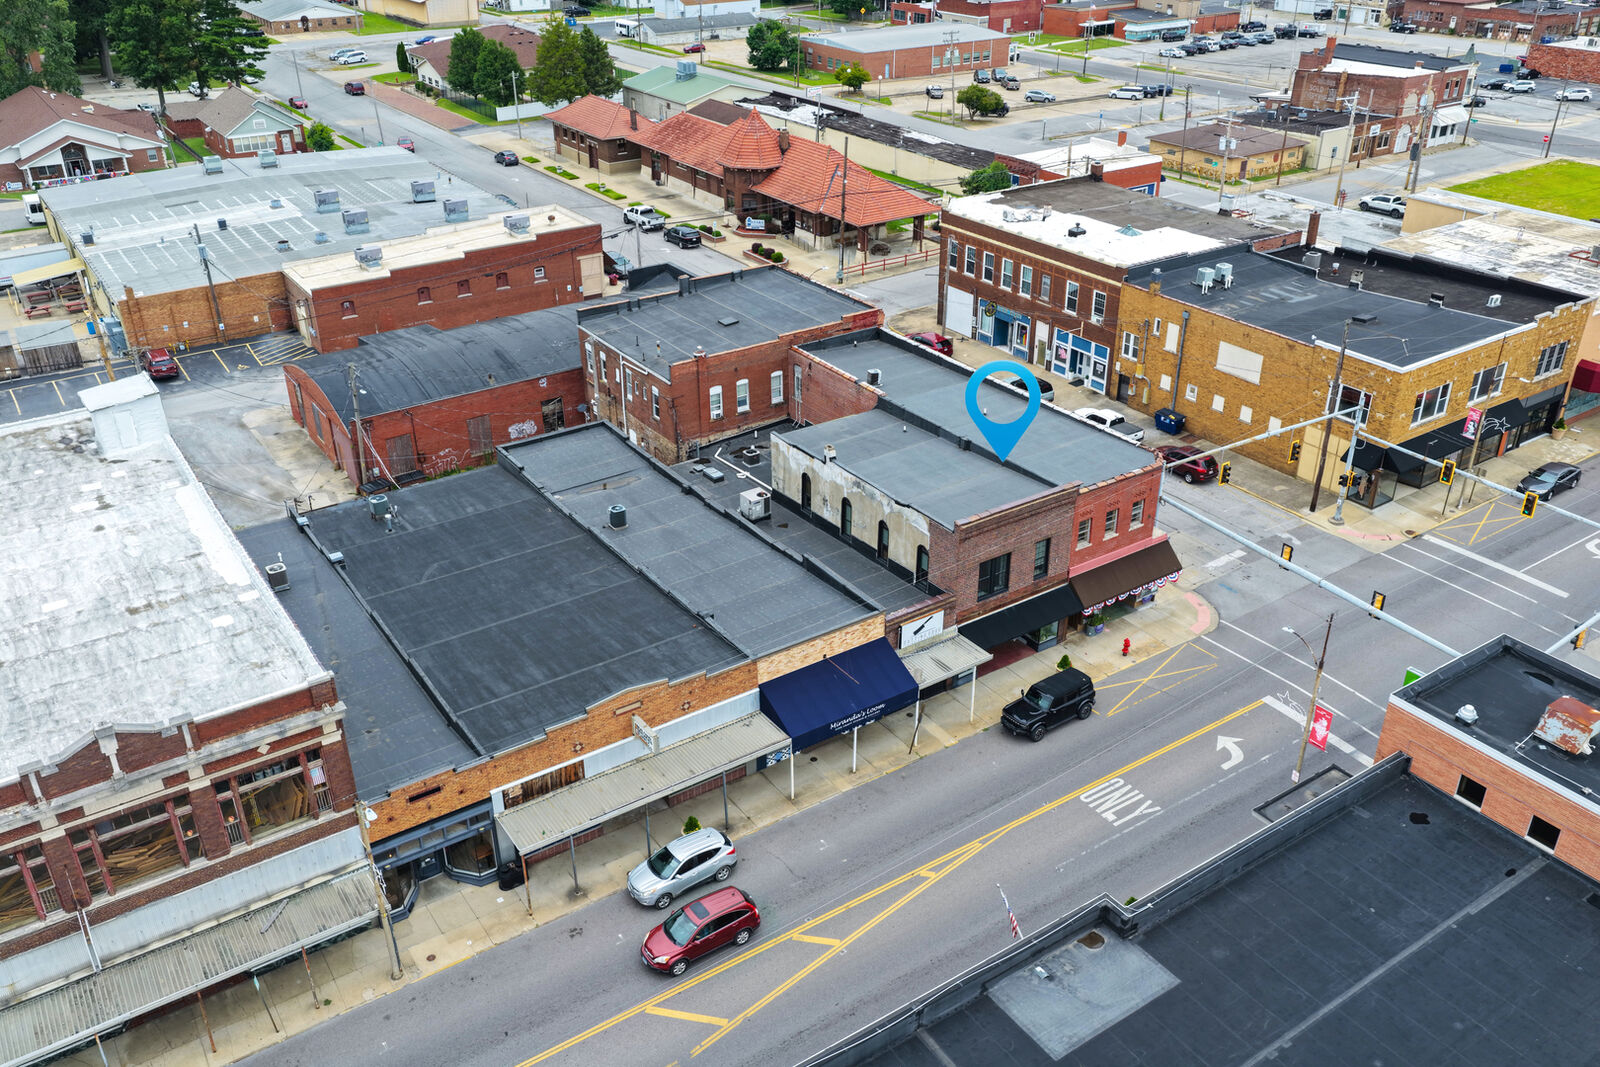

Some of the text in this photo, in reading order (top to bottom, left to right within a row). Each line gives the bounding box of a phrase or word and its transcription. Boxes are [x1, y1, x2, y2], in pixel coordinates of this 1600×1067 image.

[830, 710, 866, 729] Miranda's
[866, 703, 886, 715] Loom
[1080, 777, 1161, 826] ONLY
